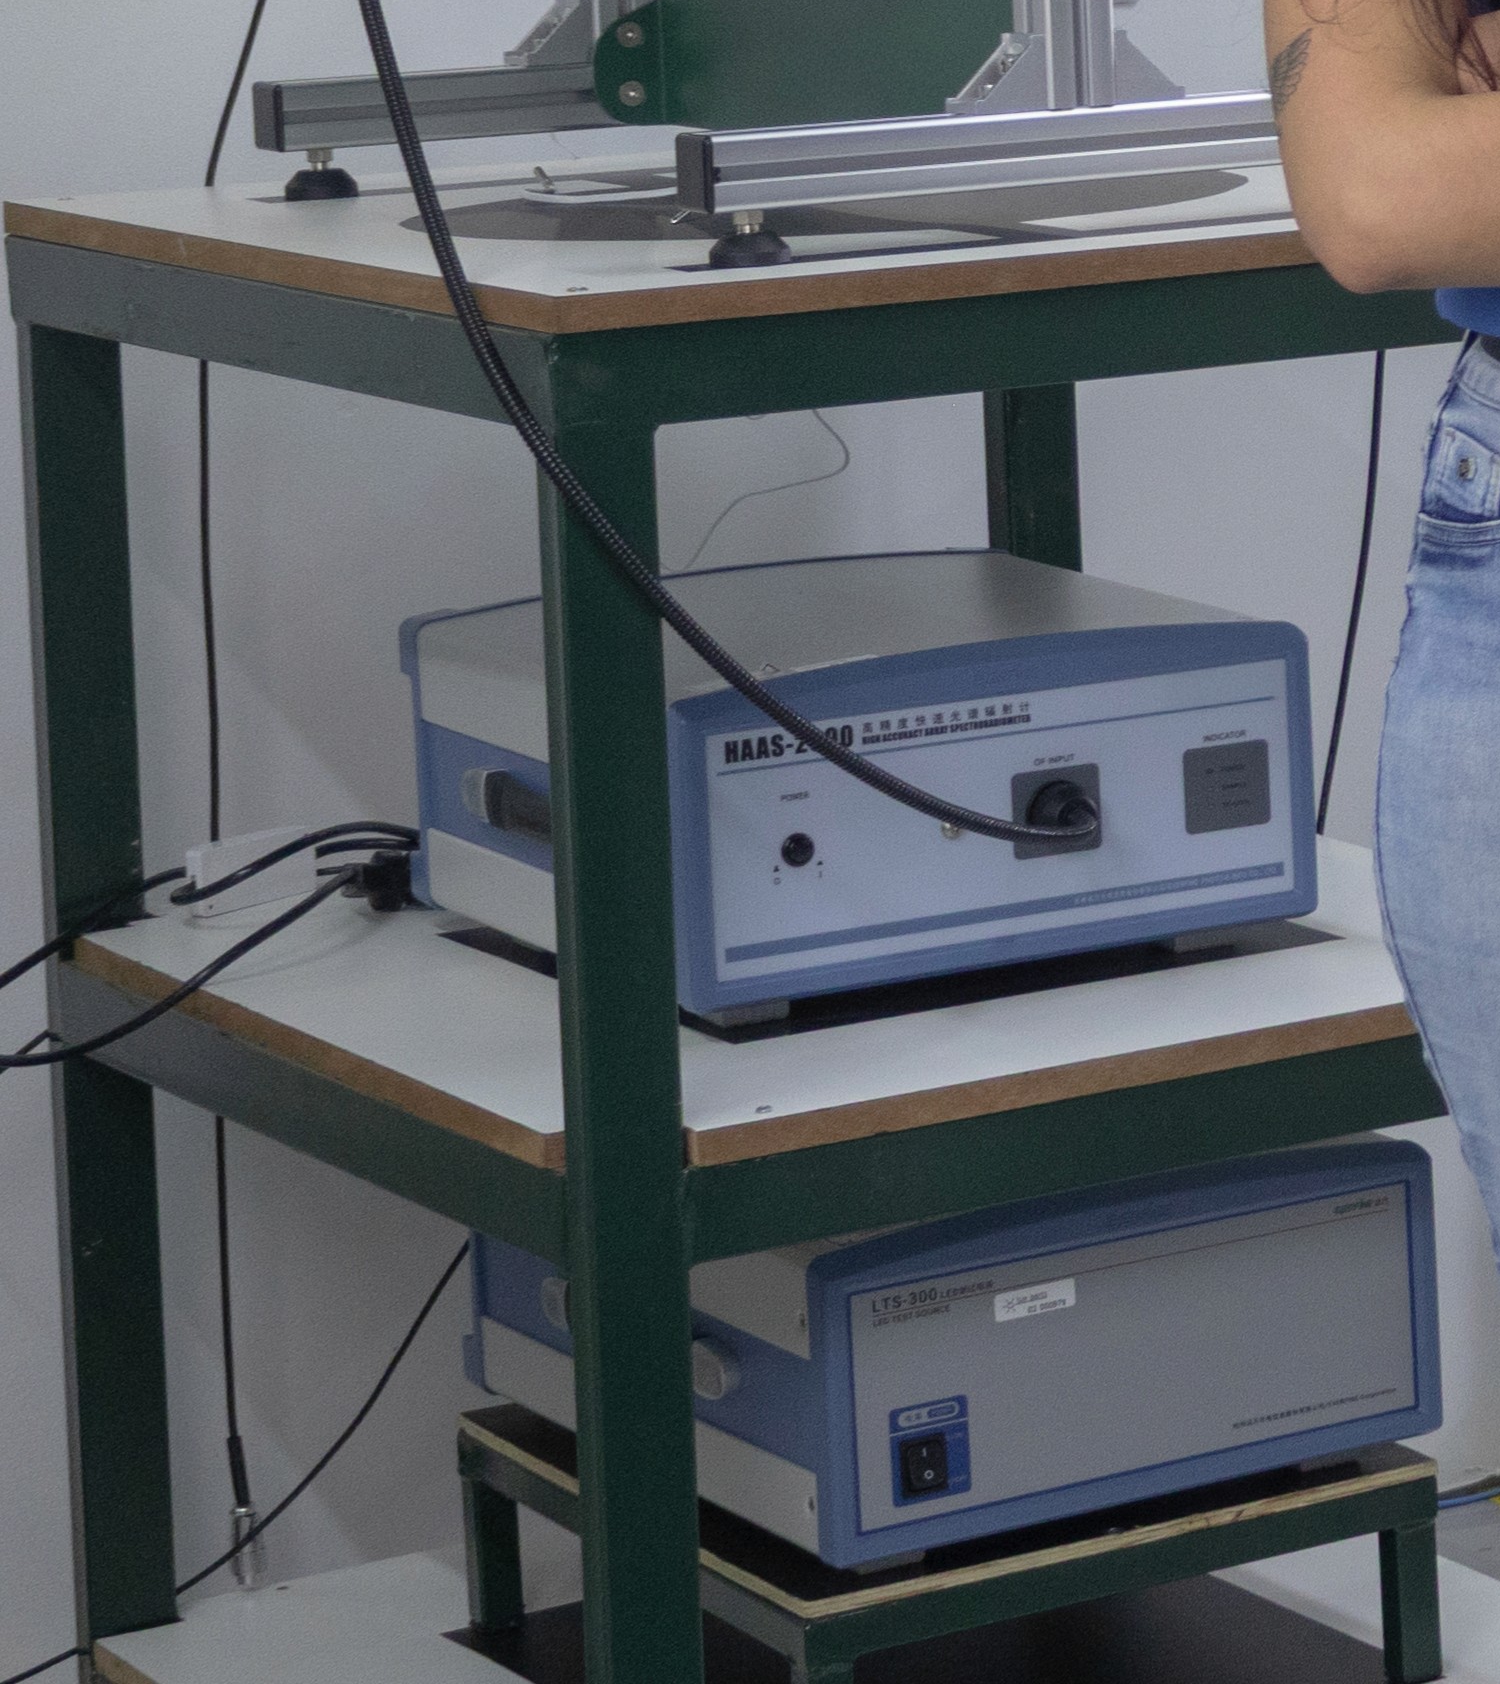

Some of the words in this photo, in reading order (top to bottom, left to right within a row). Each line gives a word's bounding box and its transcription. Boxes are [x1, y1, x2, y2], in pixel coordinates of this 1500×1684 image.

[724, 724, 855, 765] HAAS-200
[780, 790, 810, 802] POWER
[871, 1287, 938, 1314] LTS-300
